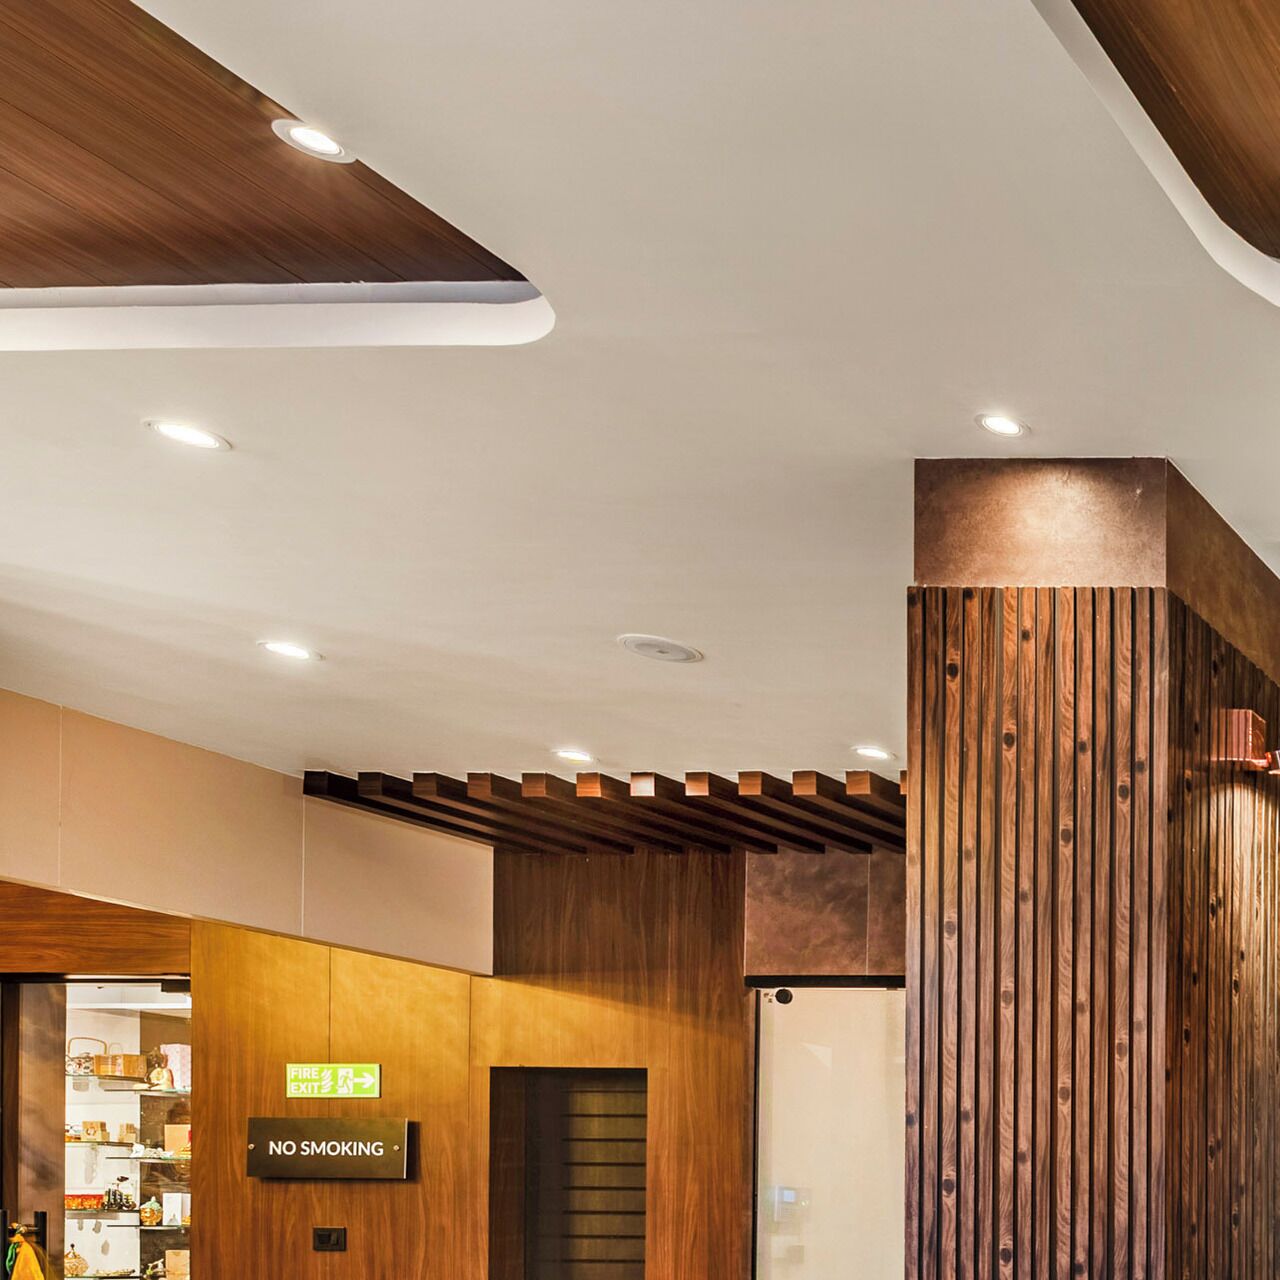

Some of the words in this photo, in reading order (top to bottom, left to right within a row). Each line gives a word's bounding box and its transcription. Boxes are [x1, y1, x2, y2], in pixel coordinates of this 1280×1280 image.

[290, 1067, 320, 1079] FIRE
[290, 1082, 320, 1094] EXIT
[268, 1140, 296, 1156] NO
[300, 1140, 384, 1157] SMOKING
